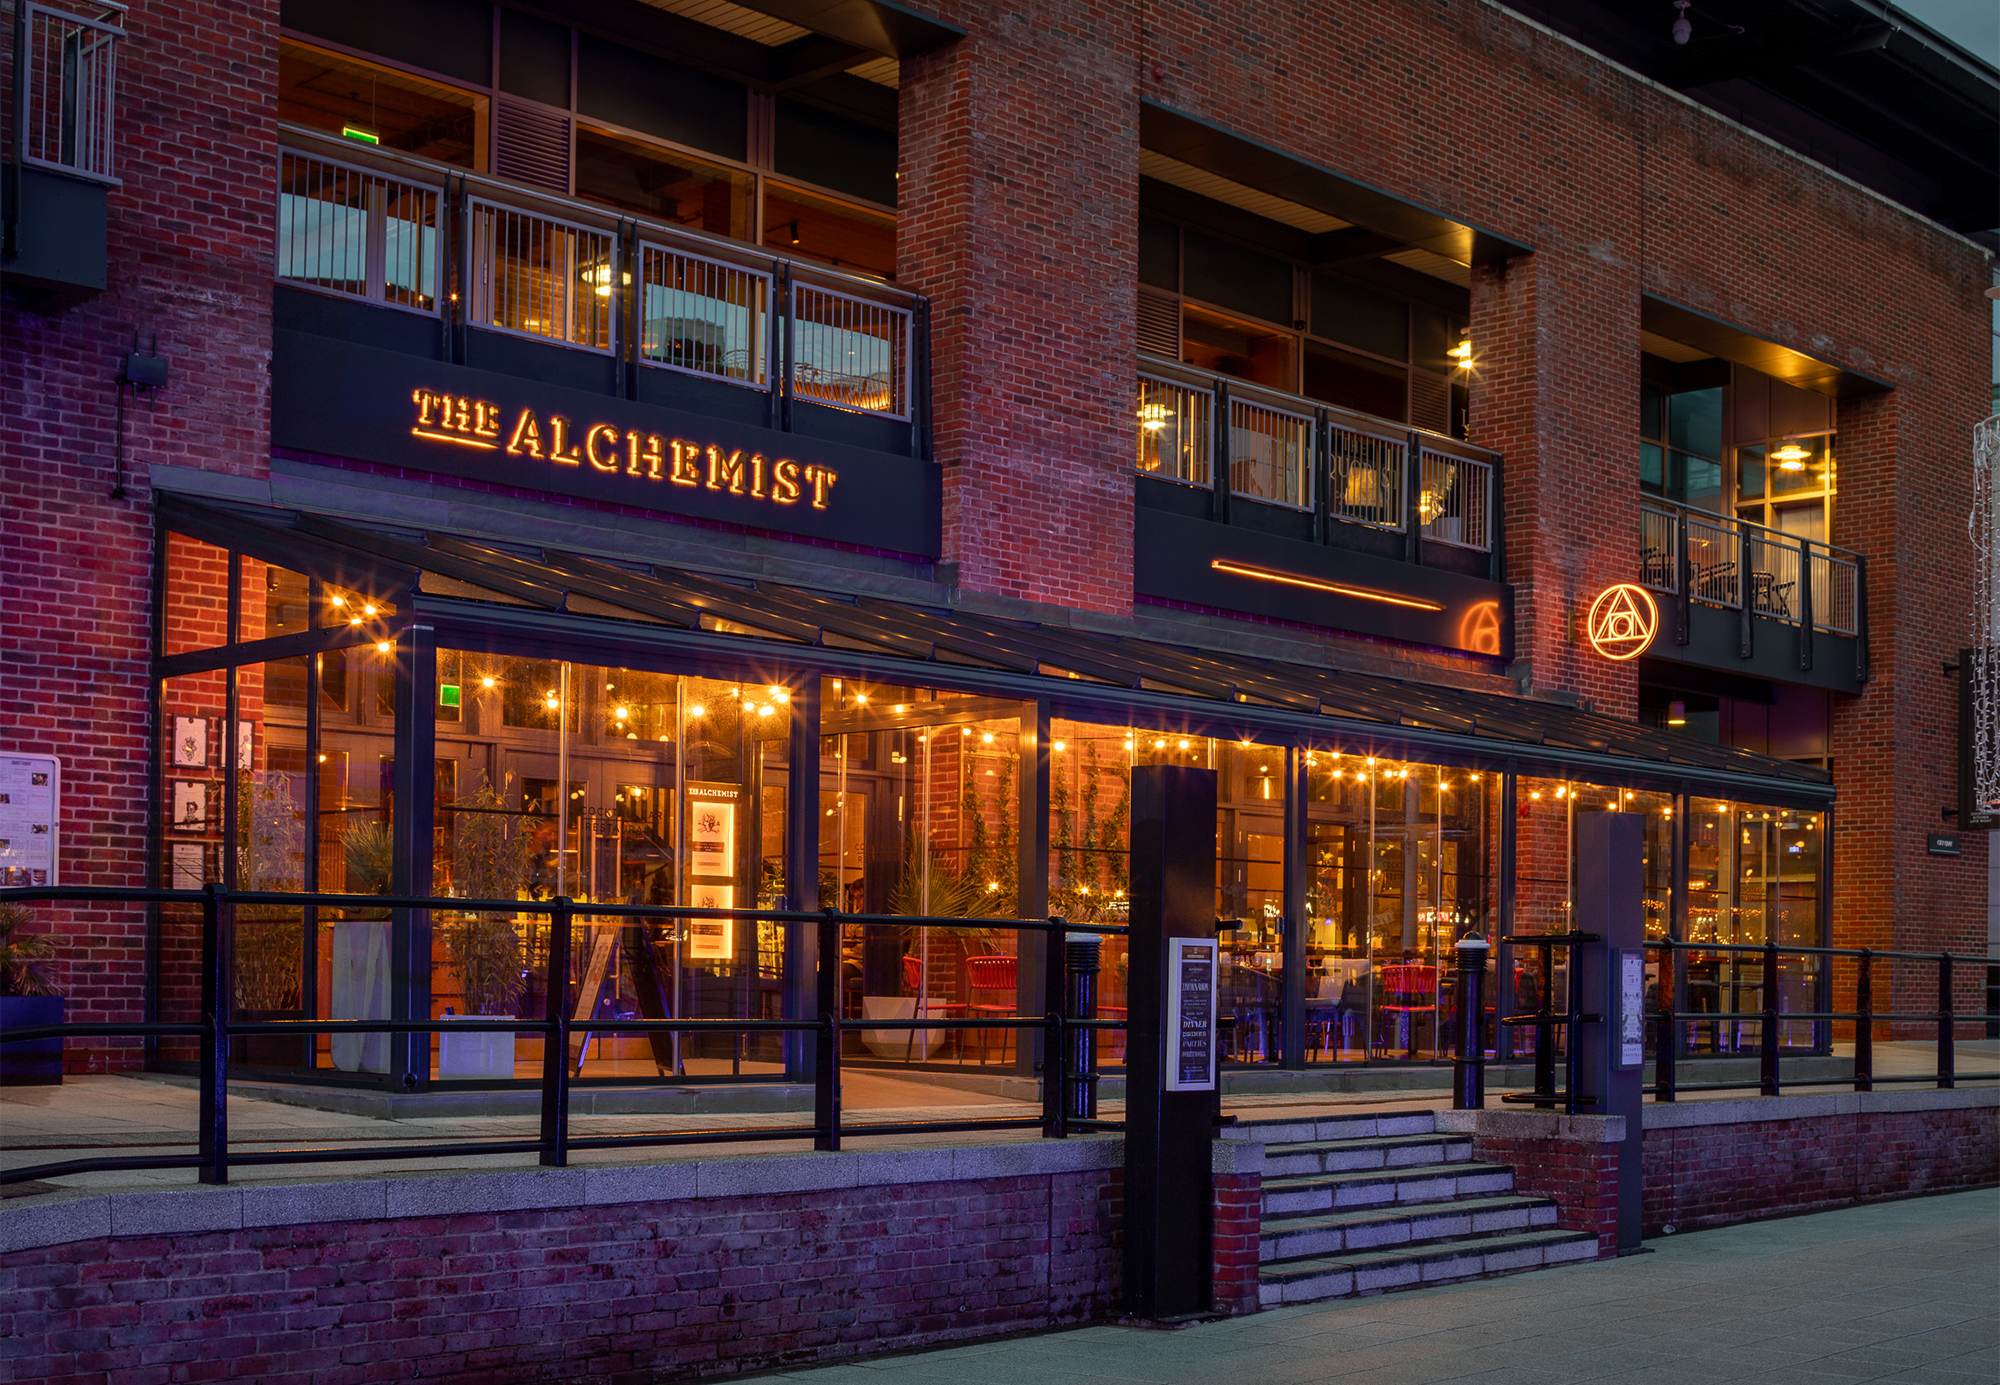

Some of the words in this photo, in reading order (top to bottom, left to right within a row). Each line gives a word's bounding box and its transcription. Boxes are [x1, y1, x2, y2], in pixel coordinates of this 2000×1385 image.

[412, 388, 500, 436] THE
[507, 408, 839, 508] ALCHEMIST
[699, 789, 738, 798] ALCHEMIST
[581, 806, 633, 818] COCKTIL
[642, 810, 662, 819] BAR
[585, 822, 648, 833] RESTAURA
